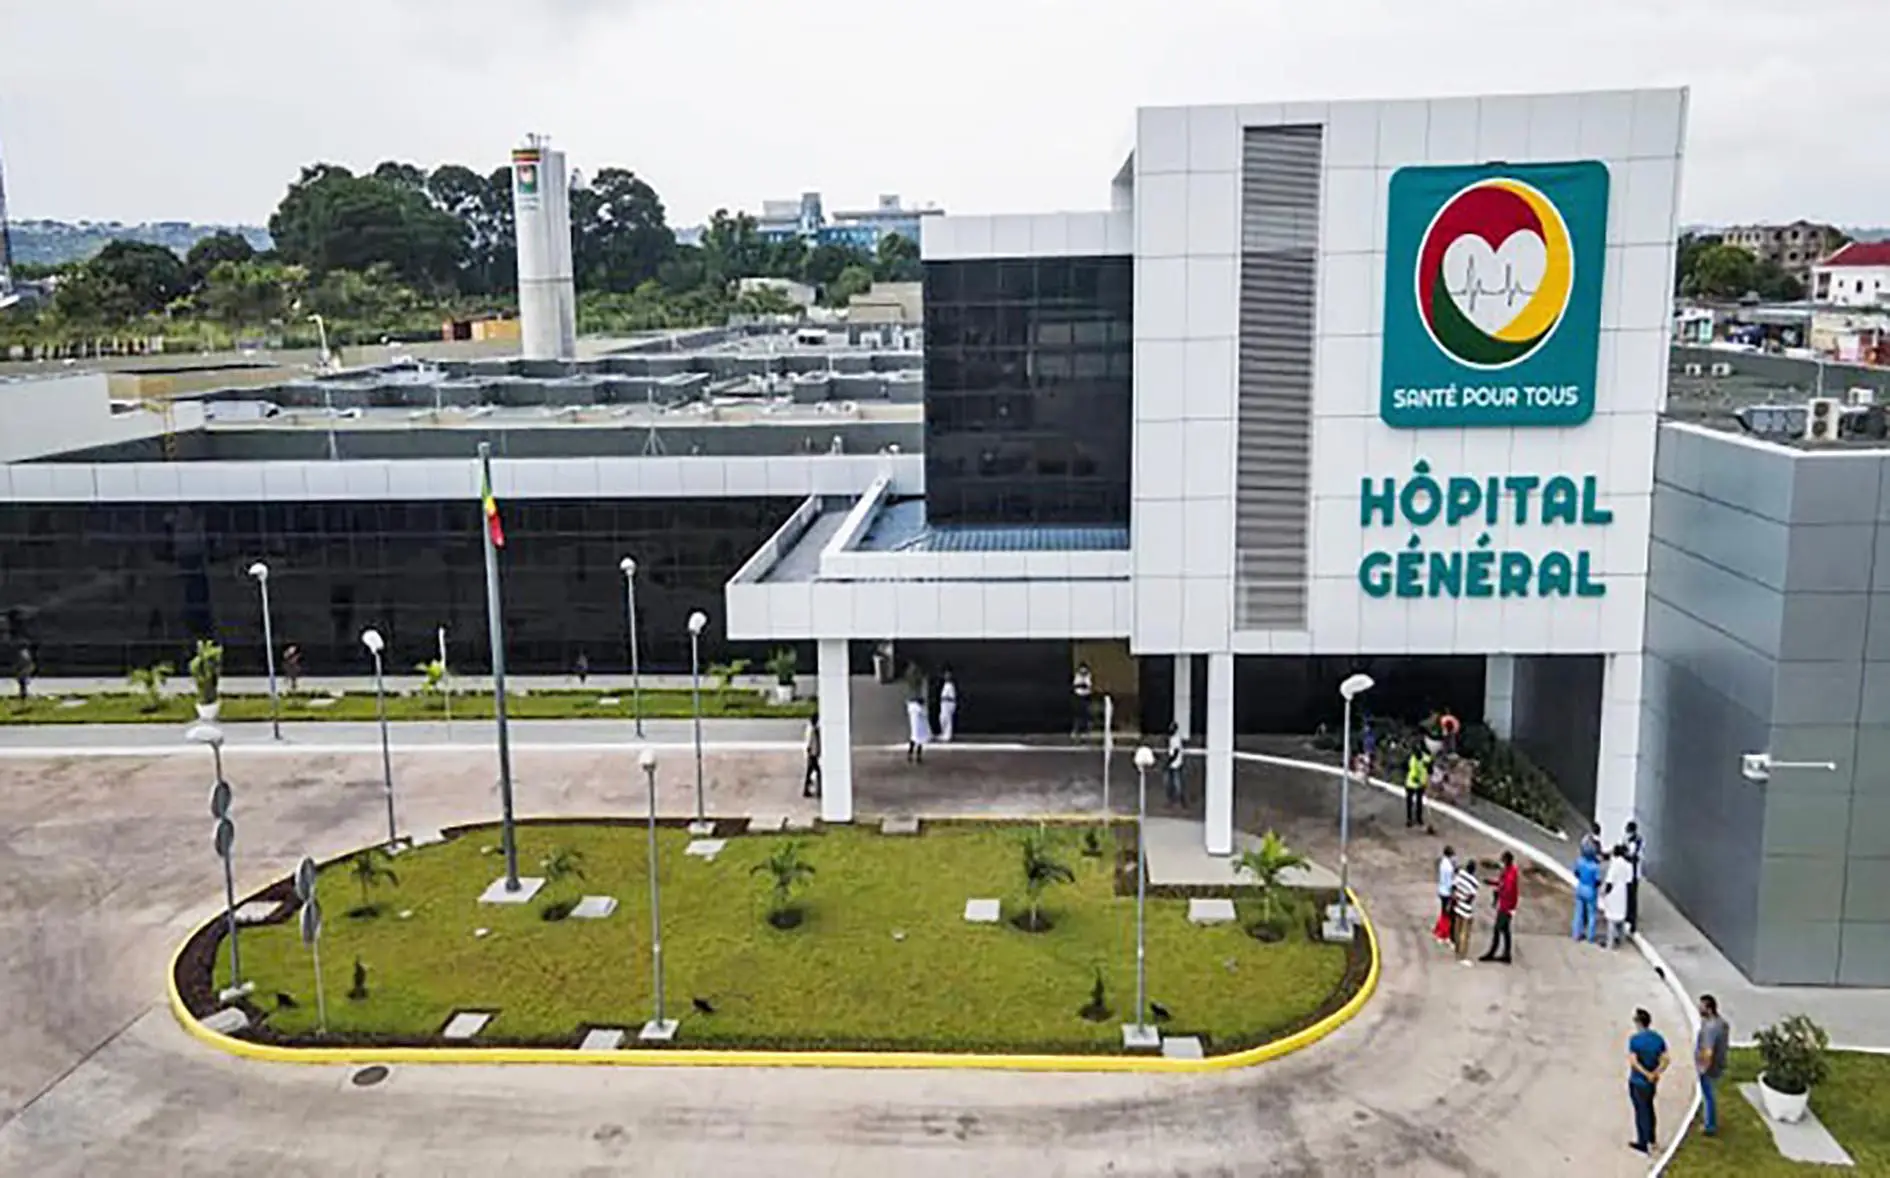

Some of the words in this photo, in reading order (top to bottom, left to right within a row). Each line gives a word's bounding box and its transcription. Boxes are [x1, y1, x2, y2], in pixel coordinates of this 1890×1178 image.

[1393, 384, 1457, 408] SANTÉ
[1462, 387, 1518, 407] POUR
[1523, 386, 1579, 406] TOUS
[1361, 459, 1613, 527] HÔPITAL
[1359, 533, 1606, 598] GÉNÉRAL
